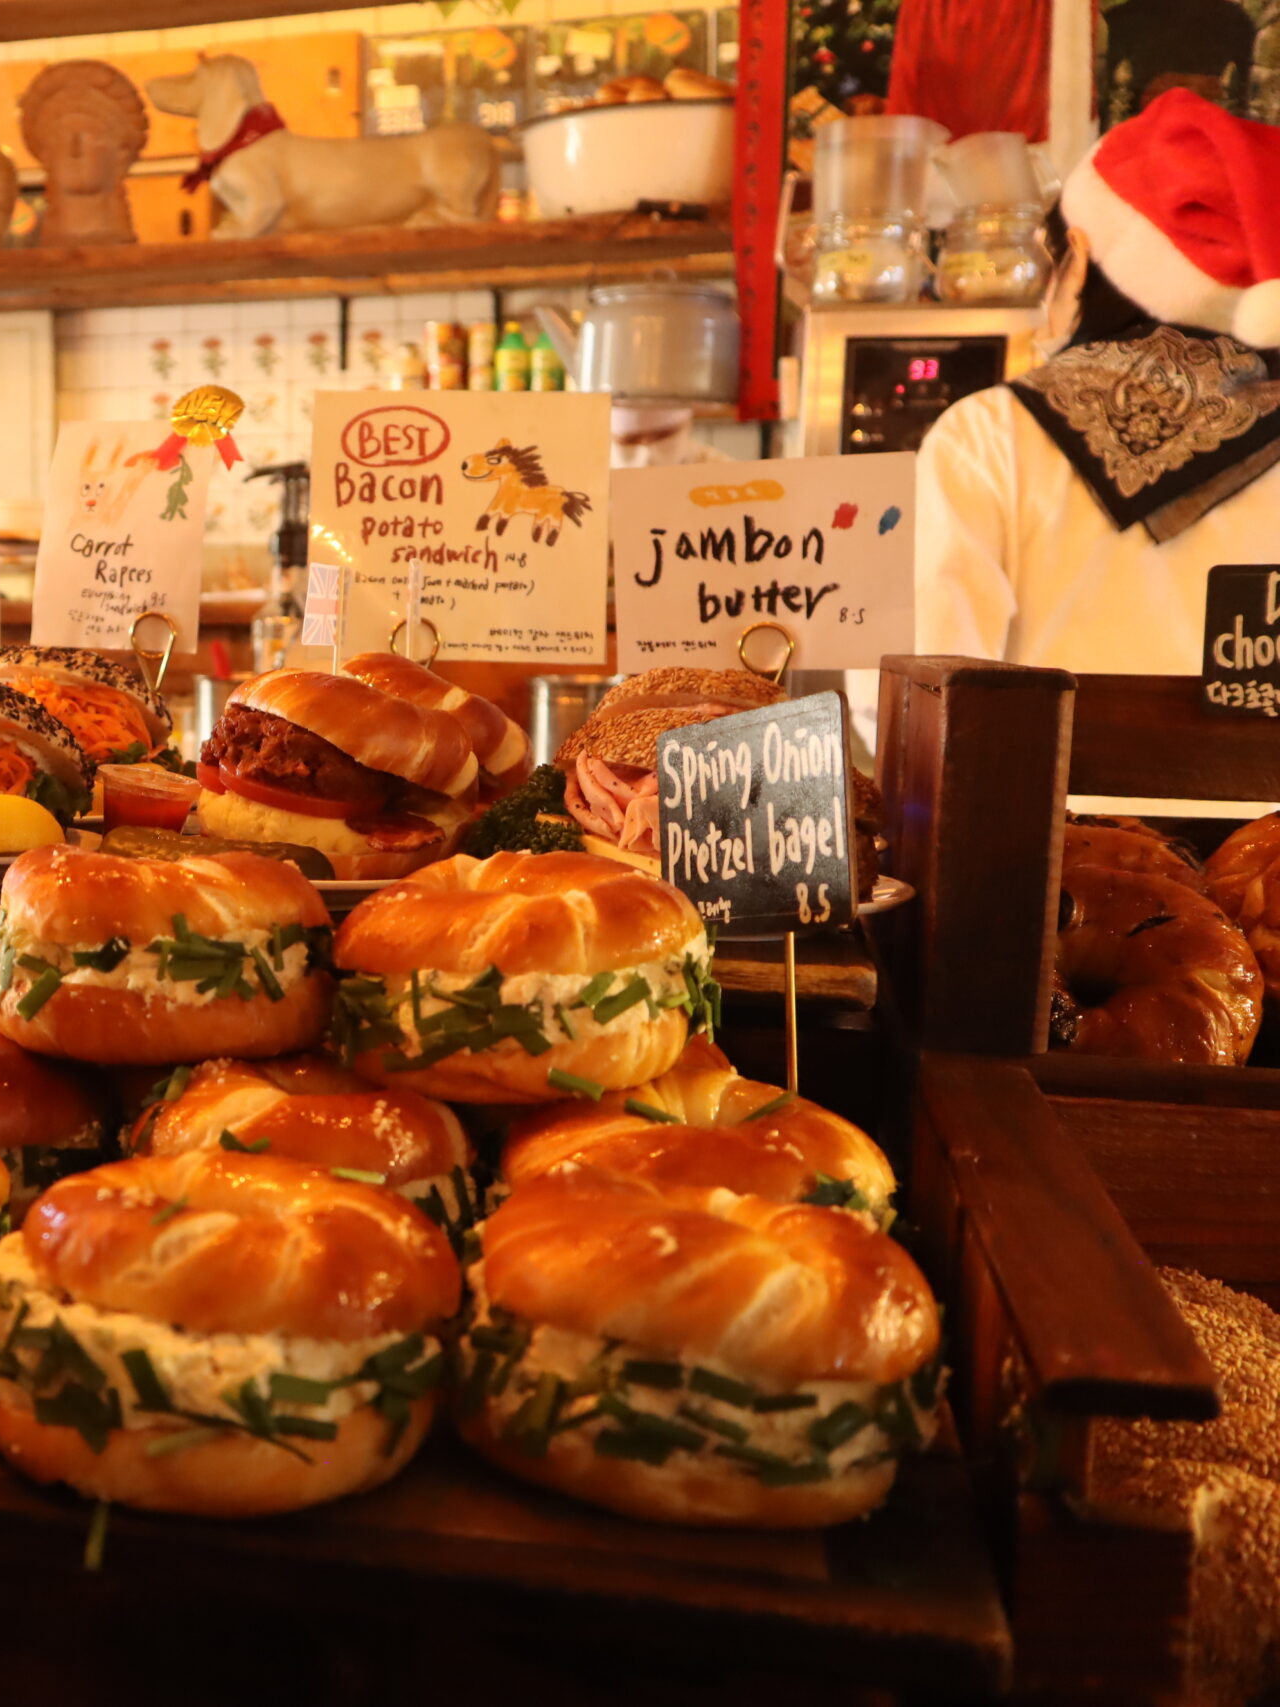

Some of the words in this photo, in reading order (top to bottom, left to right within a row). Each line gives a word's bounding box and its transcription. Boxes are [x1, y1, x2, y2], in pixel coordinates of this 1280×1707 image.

[357, 420, 431, 459] BEST
[334, 461, 444, 508] Bacon
[70, 533, 134, 558] Carrot
[361, 515, 444, 546] potato
[634, 514, 826, 588] jambon
[390, 536, 499, 573] sandwich
[697, 580, 841, 624] butter
[1213, 613, 1280, 671] cho
[662, 739, 752, 821] Spring
[763, 721, 843, 786] Onion
[667, 818, 755, 888] Pretzel
[767, 795, 845, 877] bagel
[795, 881, 832, 925] 8.5
